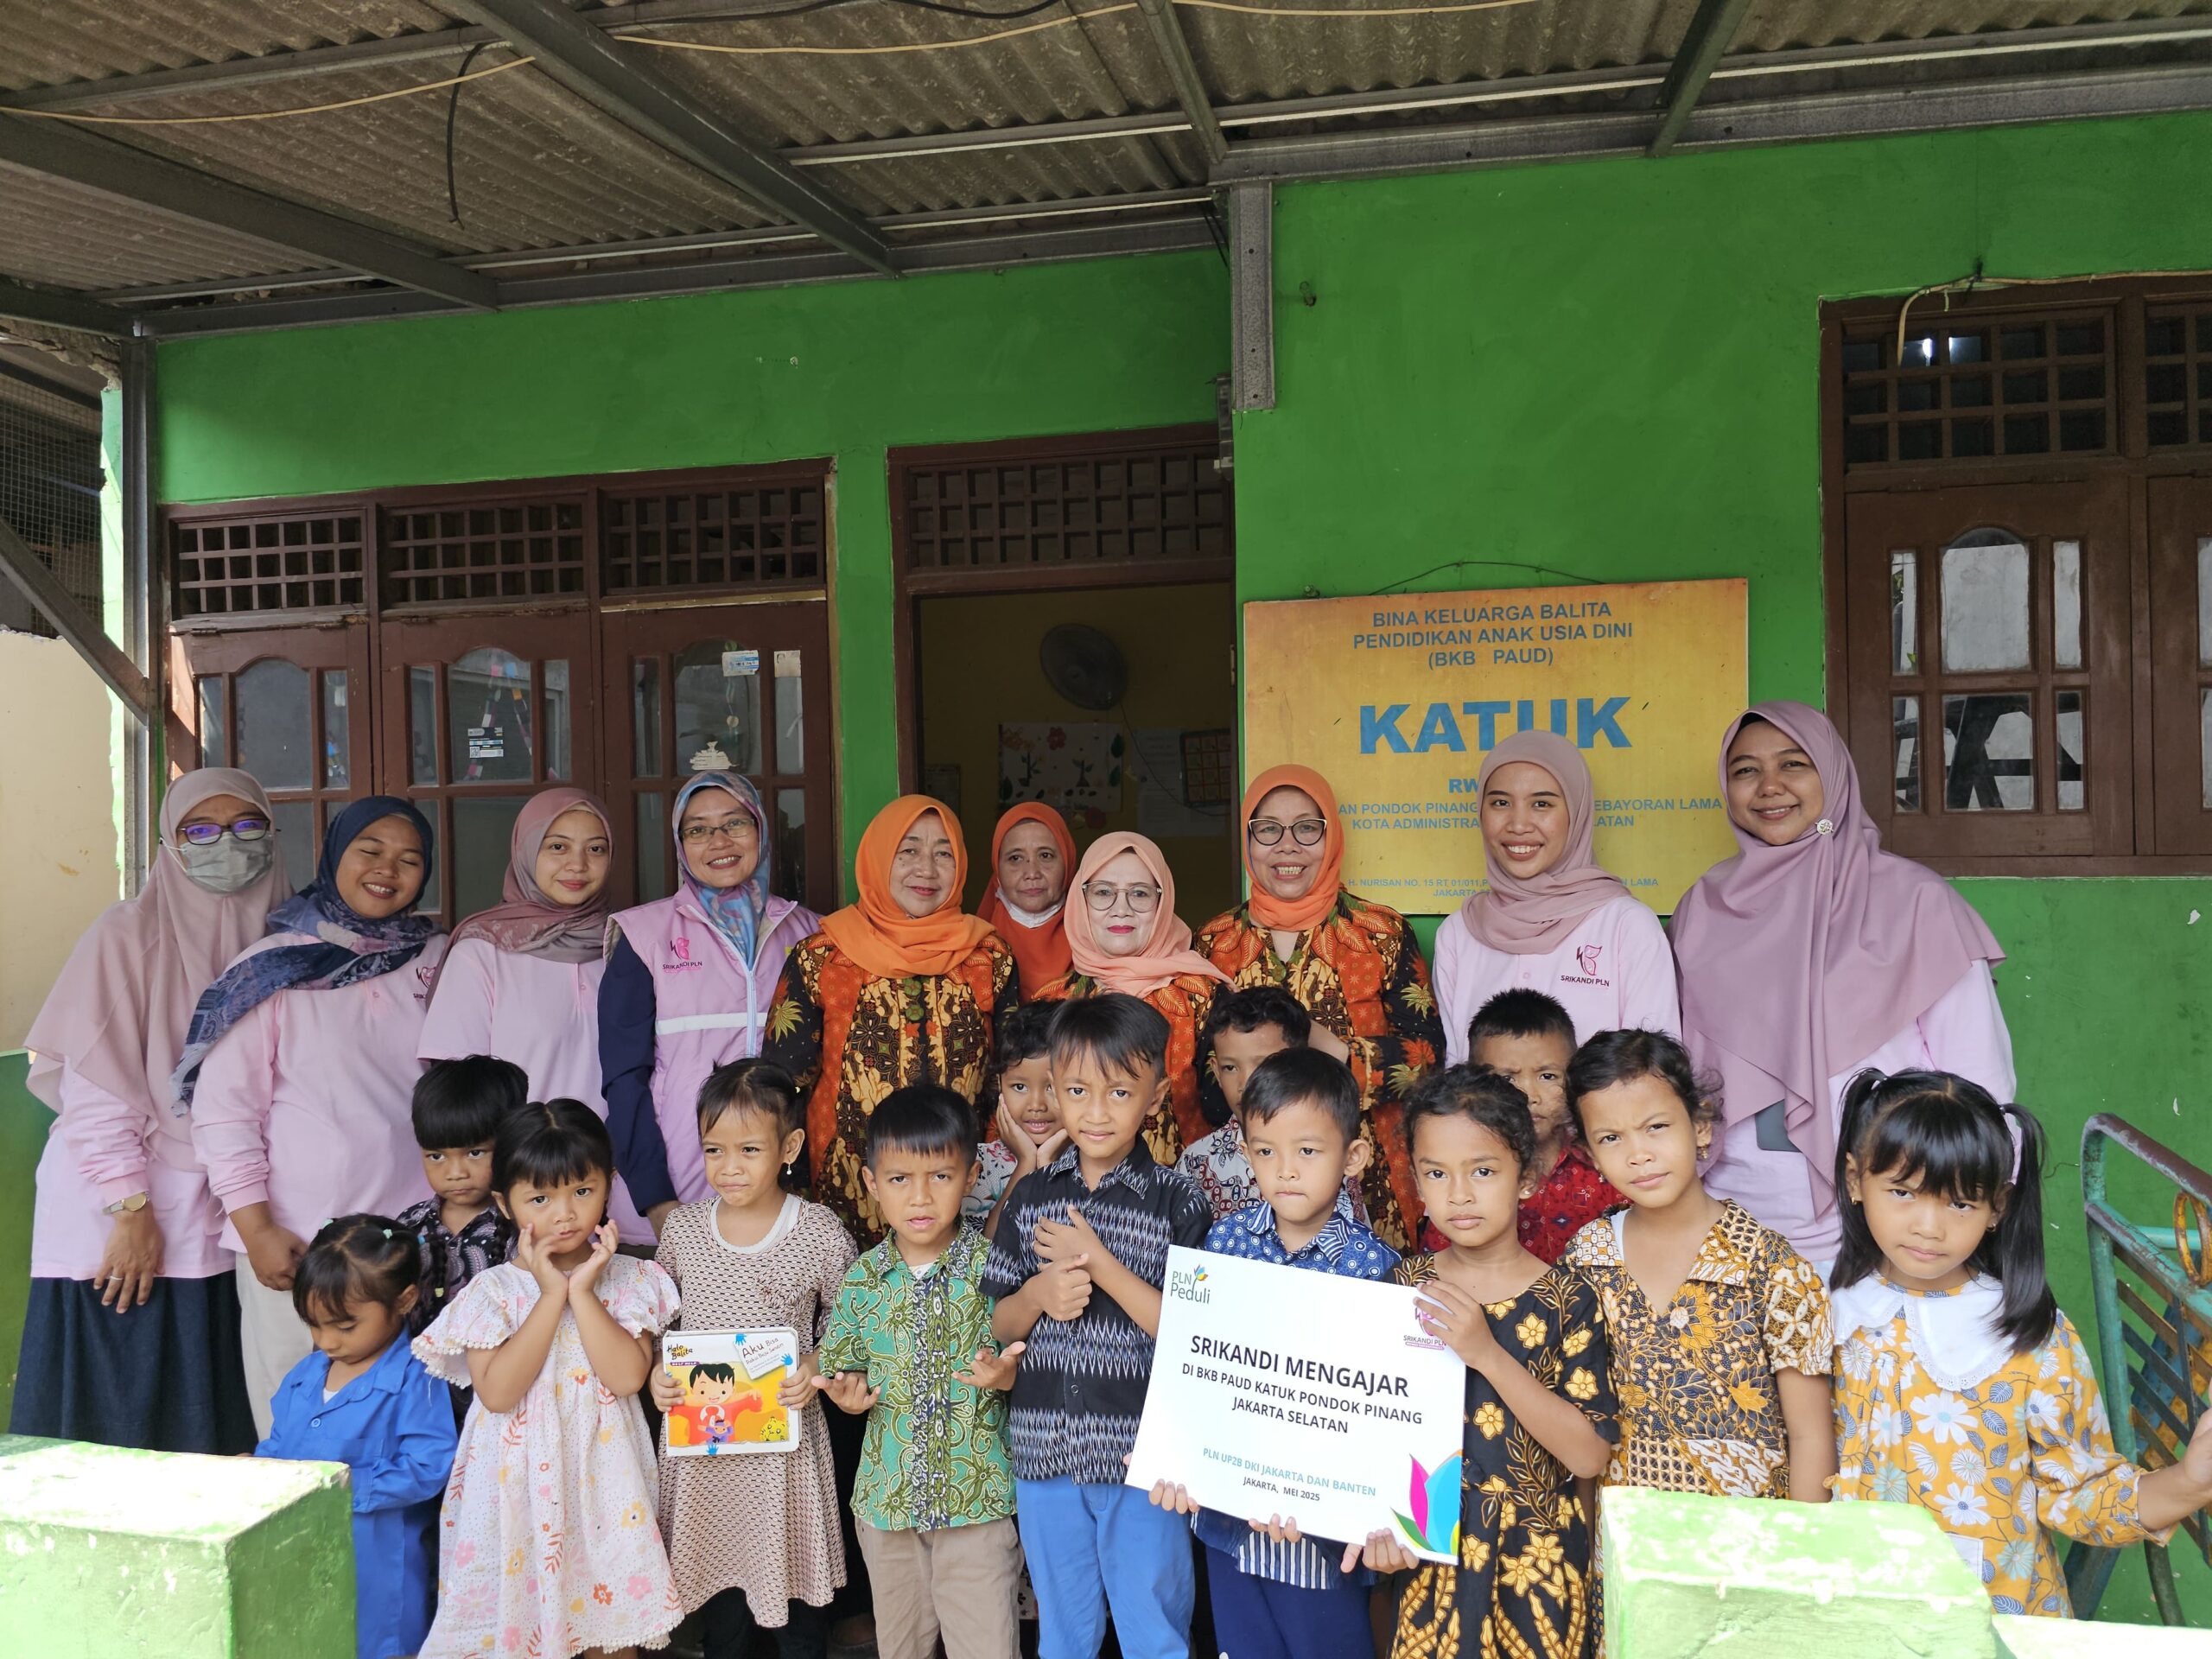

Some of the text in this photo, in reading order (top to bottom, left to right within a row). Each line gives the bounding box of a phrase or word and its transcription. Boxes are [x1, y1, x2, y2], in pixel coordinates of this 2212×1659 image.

[1373, 601, 1611, 627] BINA KELUARGA BALITA
[1354, 622, 1632, 649] PENDIDIKAN ANAK USIA DINI
[1428, 647, 1554, 671] (BKB PAUD)
[1360, 696, 1632, 754] KATUK
[1361, 803, 1421, 815] PONDOK
[1426, 802, 1478, 814] PINANG
[1593, 798, 1675, 811] EBAYORAN
[1680, 798, 1723, 810] LAMA
[1352, 815, 1634, 830] KOTA ADMINISTRA ATAN
[662, 961, 690, 969] SRIKANDI
[1560, 975, 1610, 987] SRIKANDI PLN
[1172, 1270, 1192, 1285] PLN
[1170, 1280, 1211, 1305] Peduli
[666, 1344, 684, 1353] Halo
[742, 1344, 765, 1358] Aku
[1403, 1335, 1433, 1344] SRIKANDI
[671, 1348, 694, 1360] Balita
[1191, 1335, 1409, 1397] SRIKANDI MENGAJAR
[1182, 1363, 1422, 1424] DI BKB PAUD KATUK PONDOK PINANG
[1232, 1396, 1348, 1433] JAKARTA SELATAN
[1203, 1447, 1376, 1496] PLN UP2B DKI JAKARTA DAN BANTEN
[1243, 1477, 1320, 1501] JAKARTA, MEI 2025
